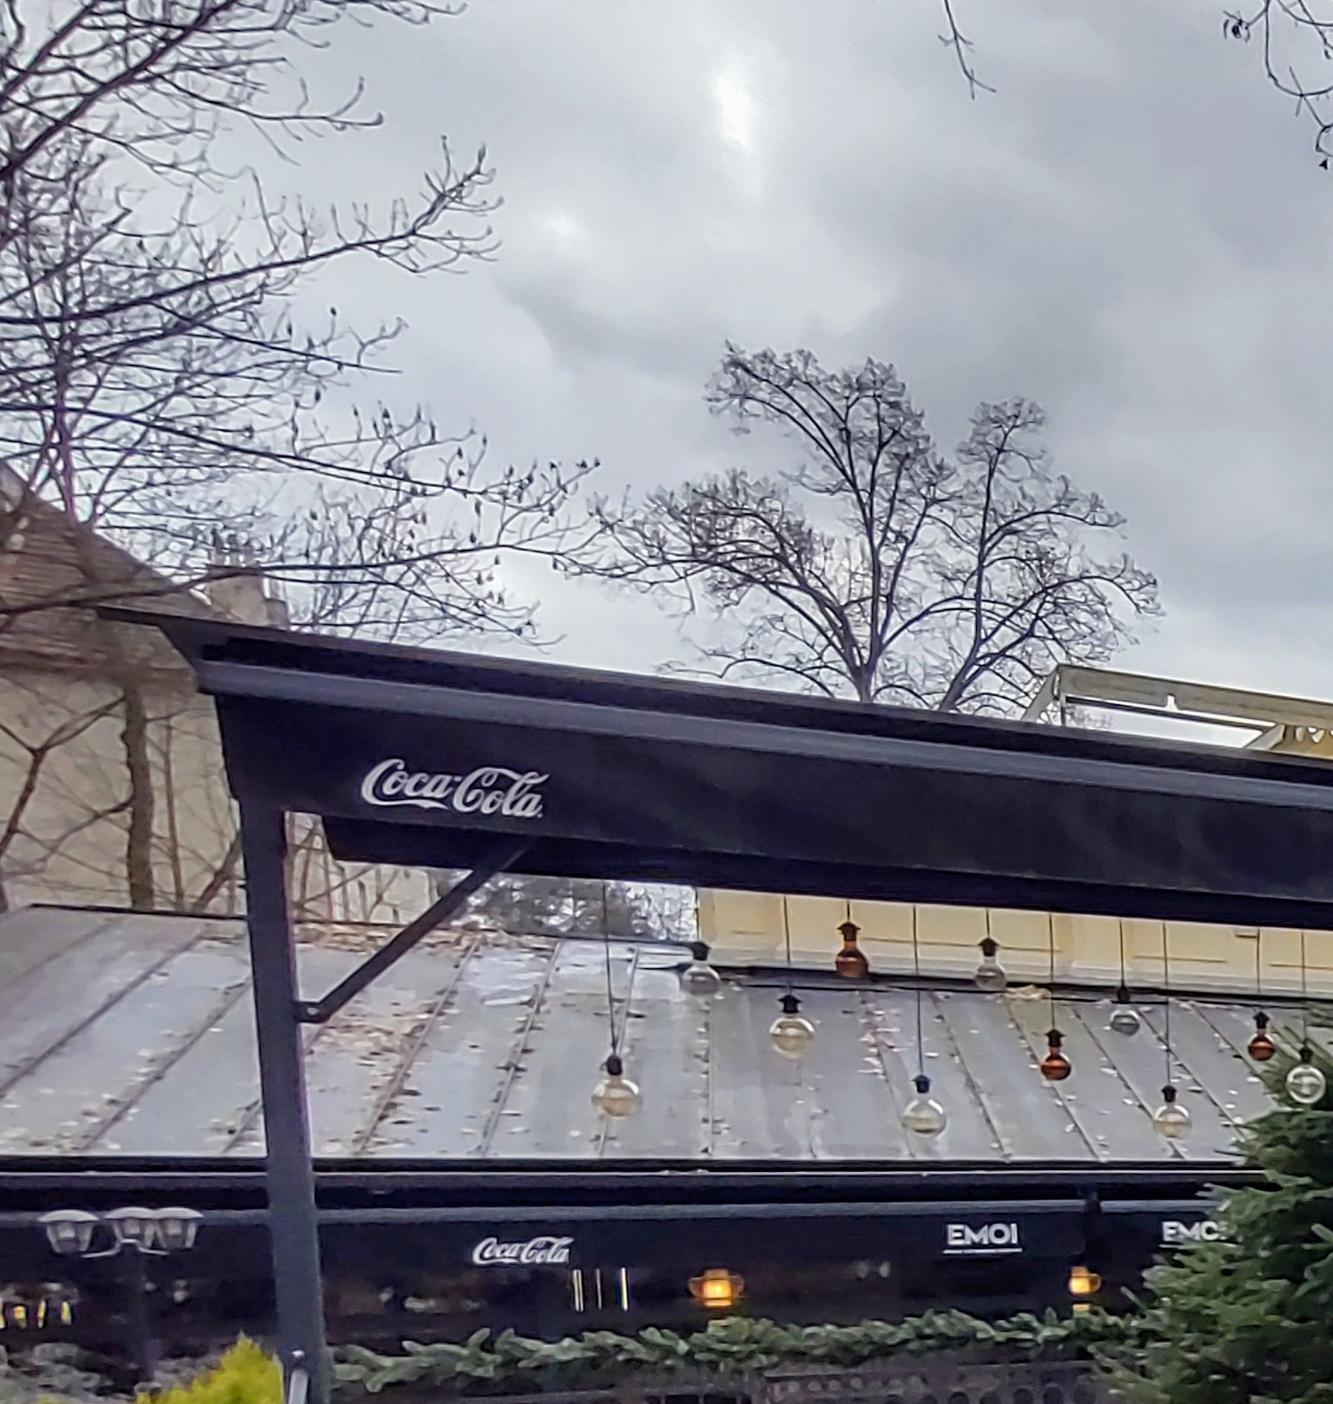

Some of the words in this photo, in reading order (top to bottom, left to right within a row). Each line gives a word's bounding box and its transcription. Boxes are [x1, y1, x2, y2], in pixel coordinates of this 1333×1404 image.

[361, 758, 549, 818] Coca-Cola
[946, 1222, 1018, 1246] EMOI
[1162, 1221, 1219, 1242] EMO
[472, 1236, 575, 1264] Coca-Cola
